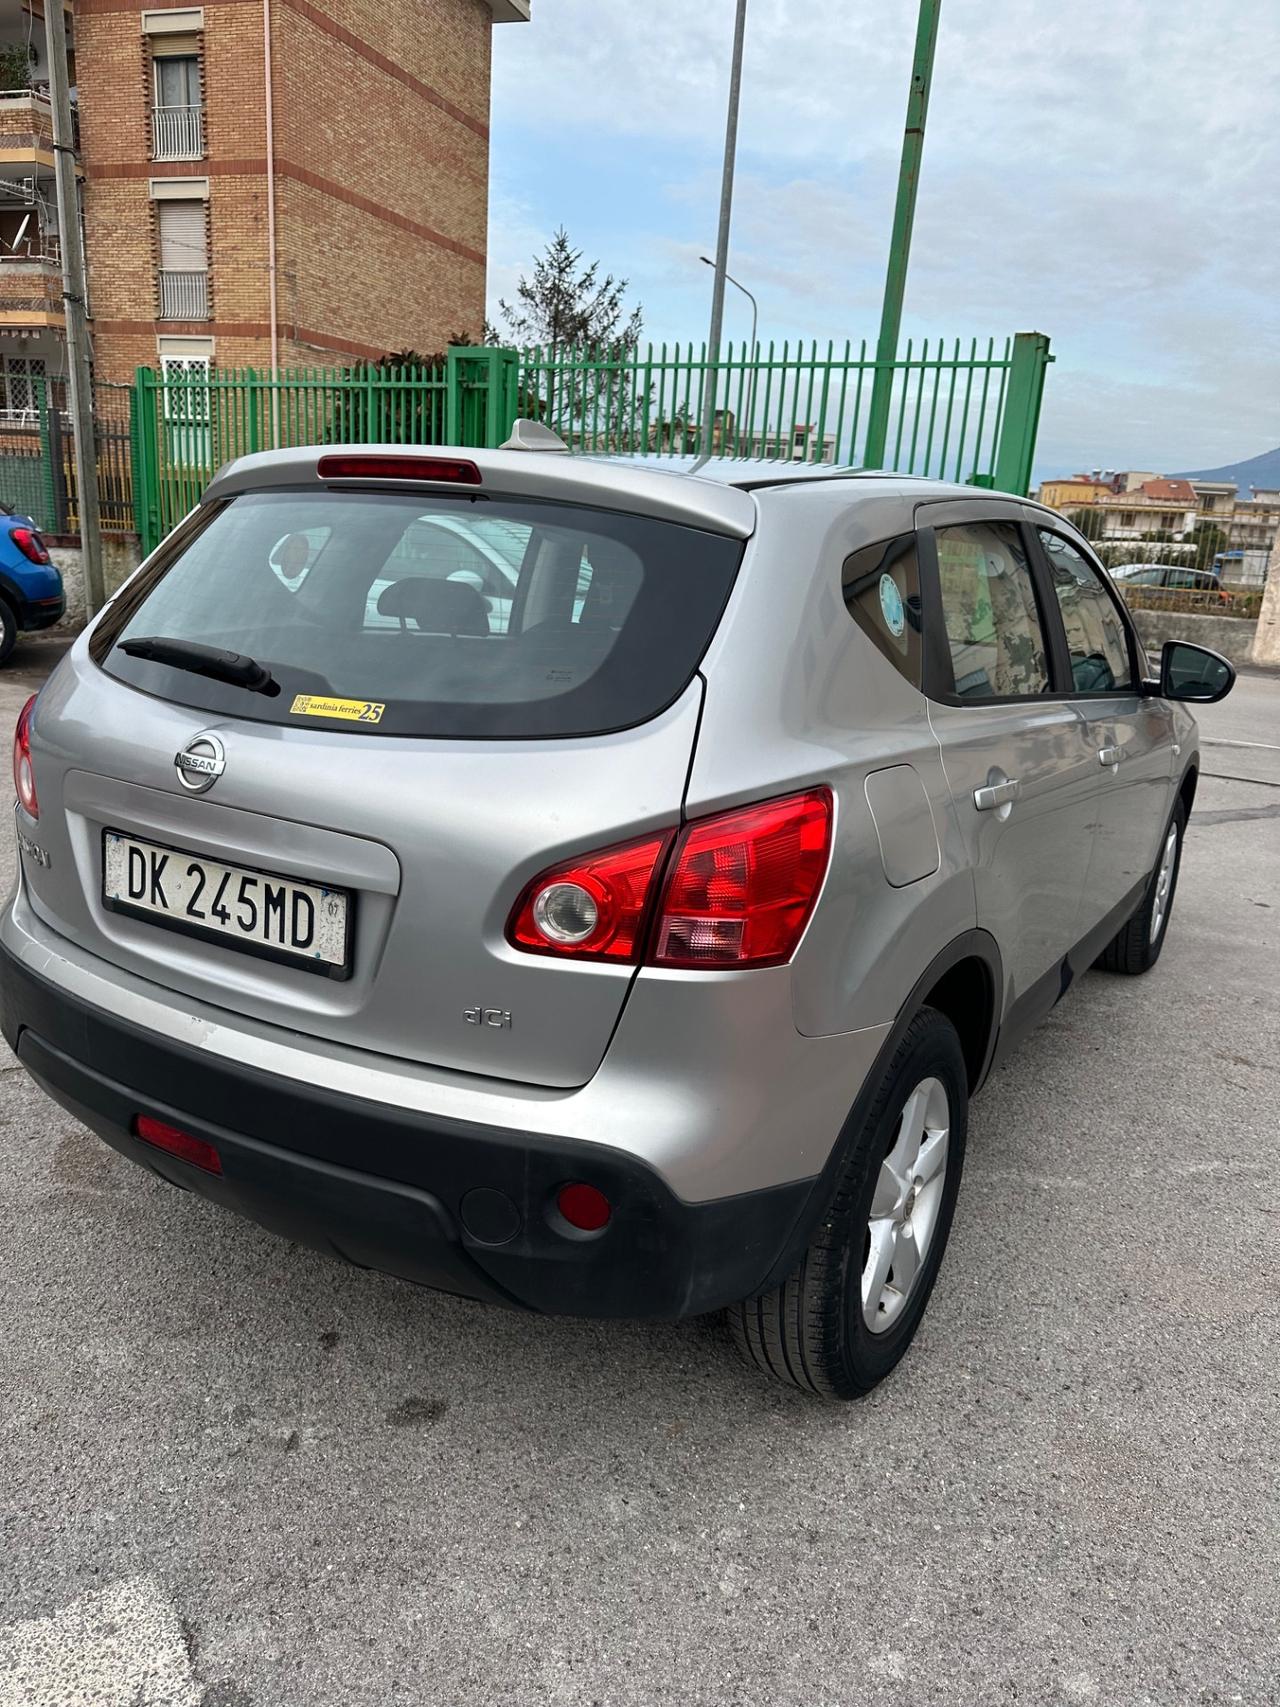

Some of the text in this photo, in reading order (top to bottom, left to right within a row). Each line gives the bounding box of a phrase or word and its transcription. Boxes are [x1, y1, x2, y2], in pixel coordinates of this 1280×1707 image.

[310, 702, 382, 721] sardinia ferries 25
[175, 752, 216, 771] NISSAN
[128, 845, 170, 909] DK
[186, 863, 315, 949] 245MD
[463, 1005, 512, 1030] dCi
